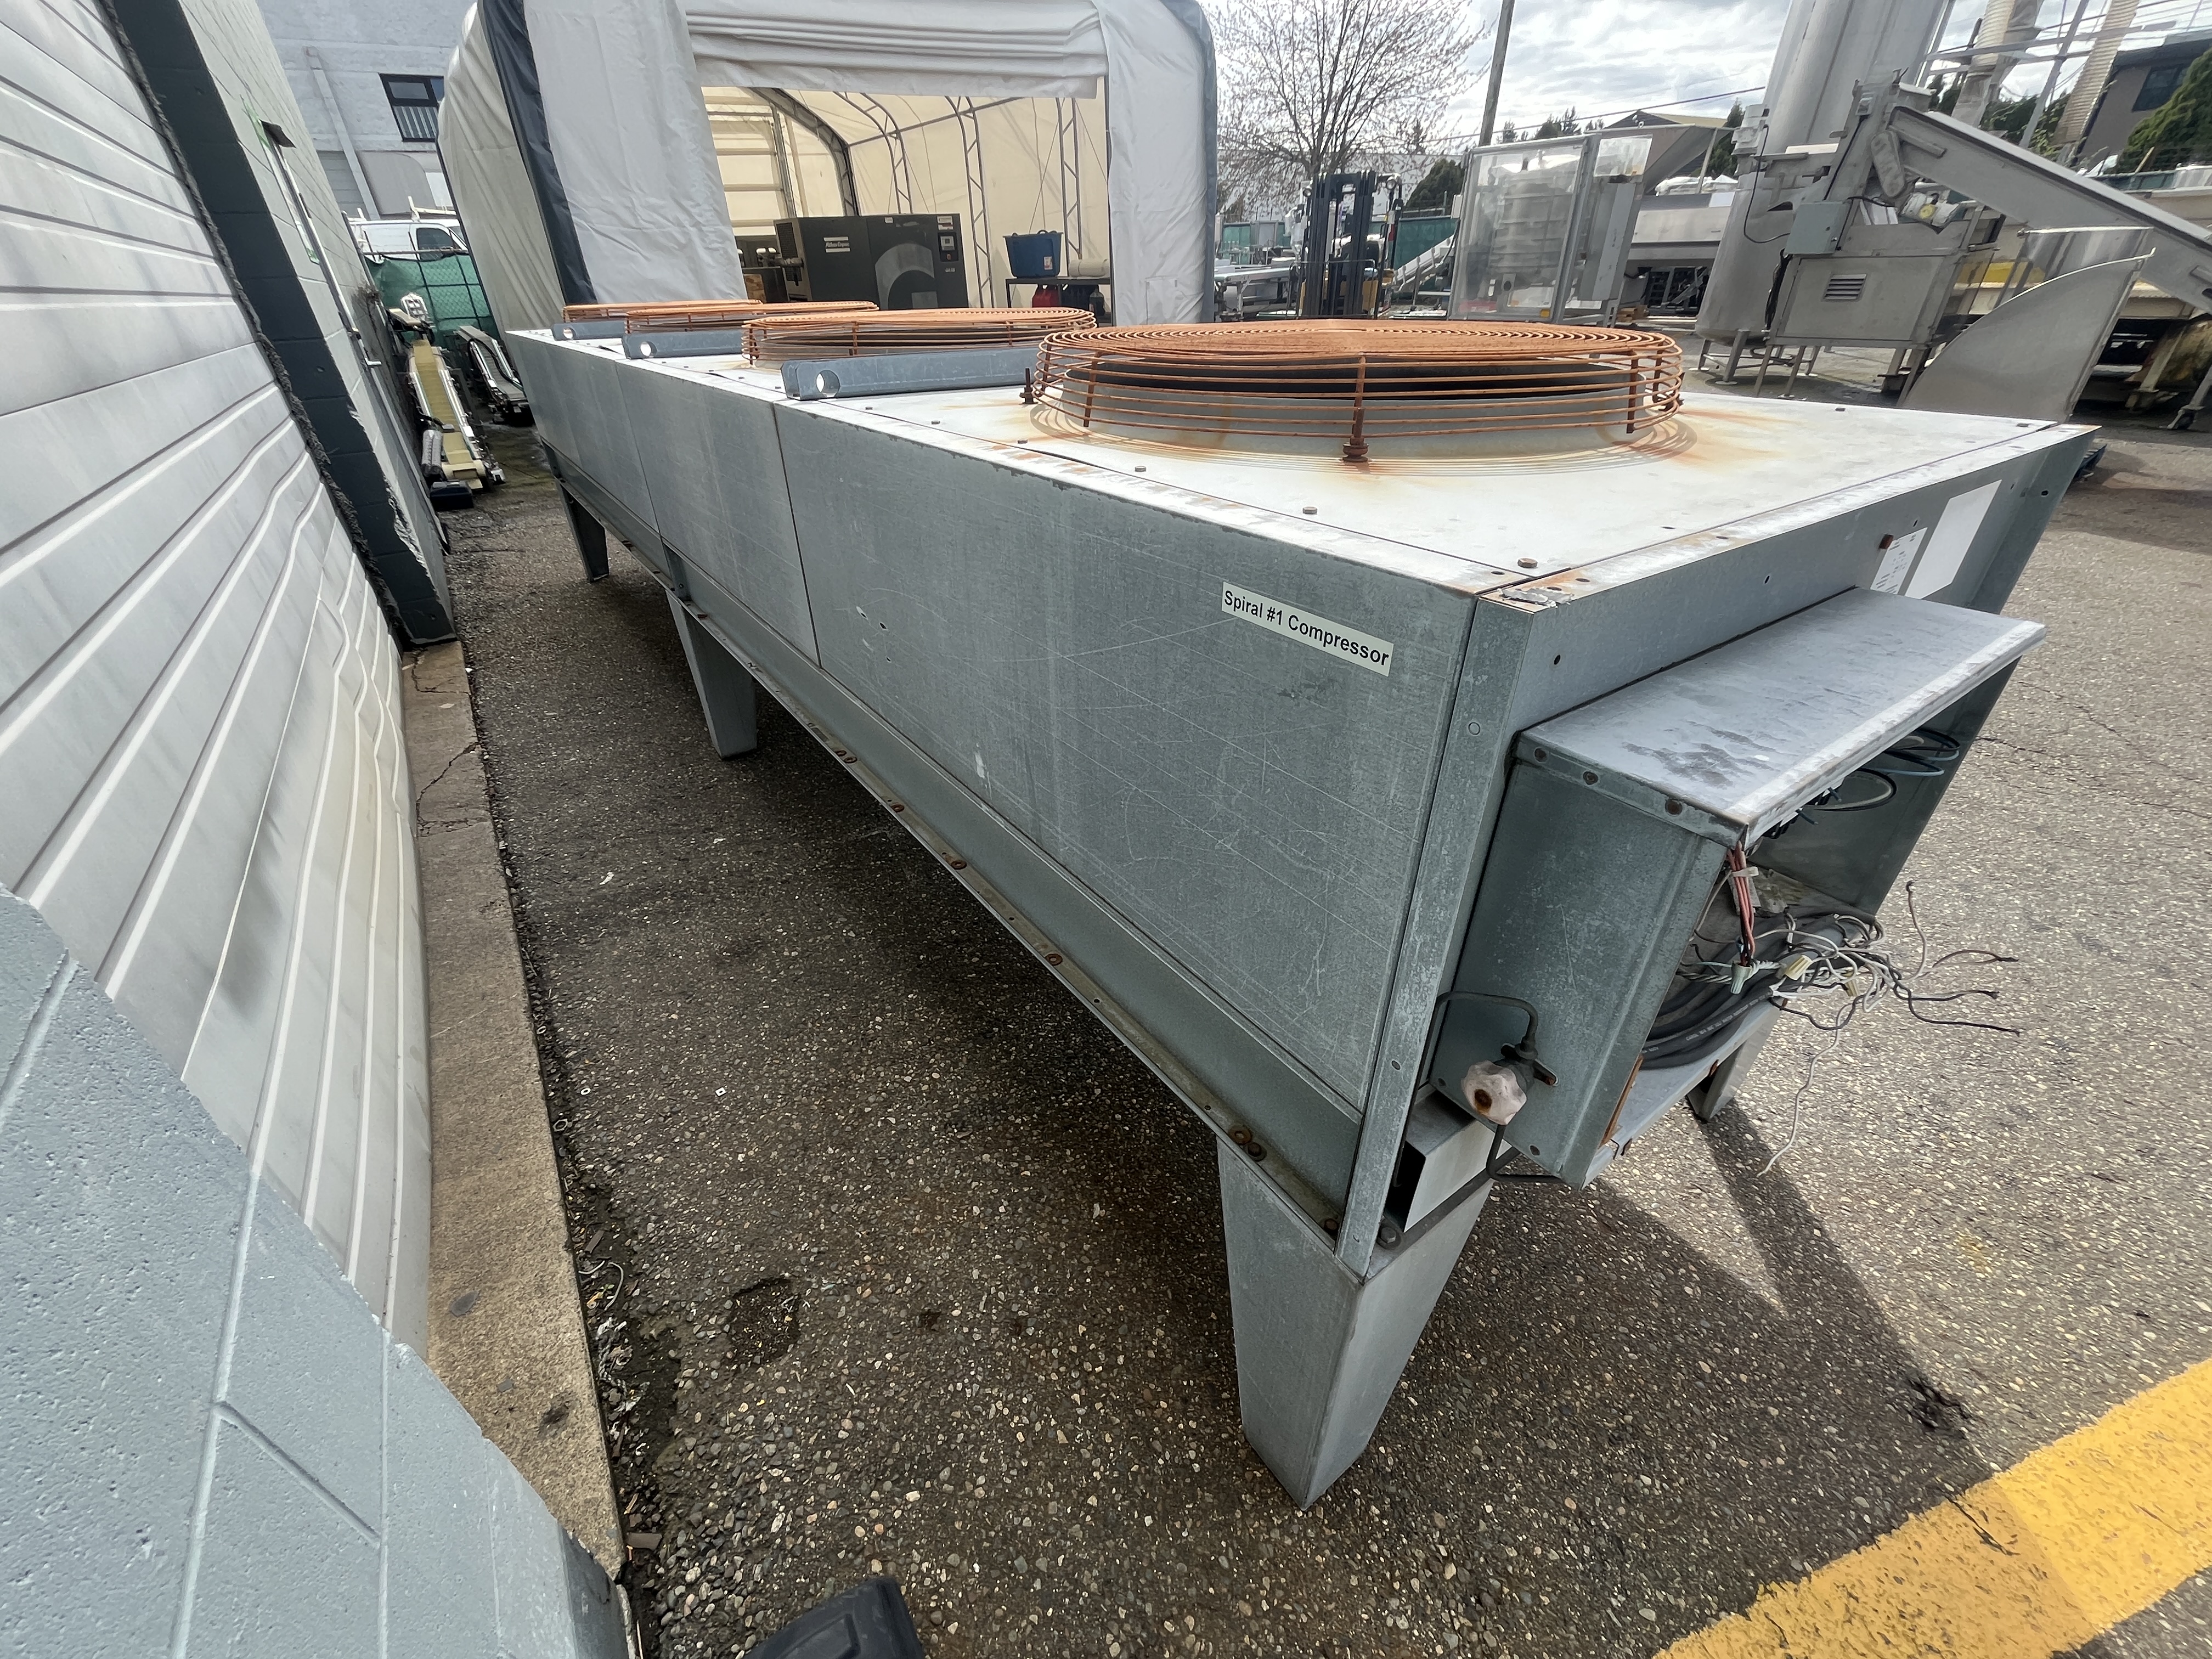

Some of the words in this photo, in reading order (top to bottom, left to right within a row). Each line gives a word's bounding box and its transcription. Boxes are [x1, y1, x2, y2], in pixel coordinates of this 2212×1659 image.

[1224, 590, 1263, 618] Spiral
[1267, 606, 1283, 625] #1
[1288, 614, 1390, 665] Compressor
